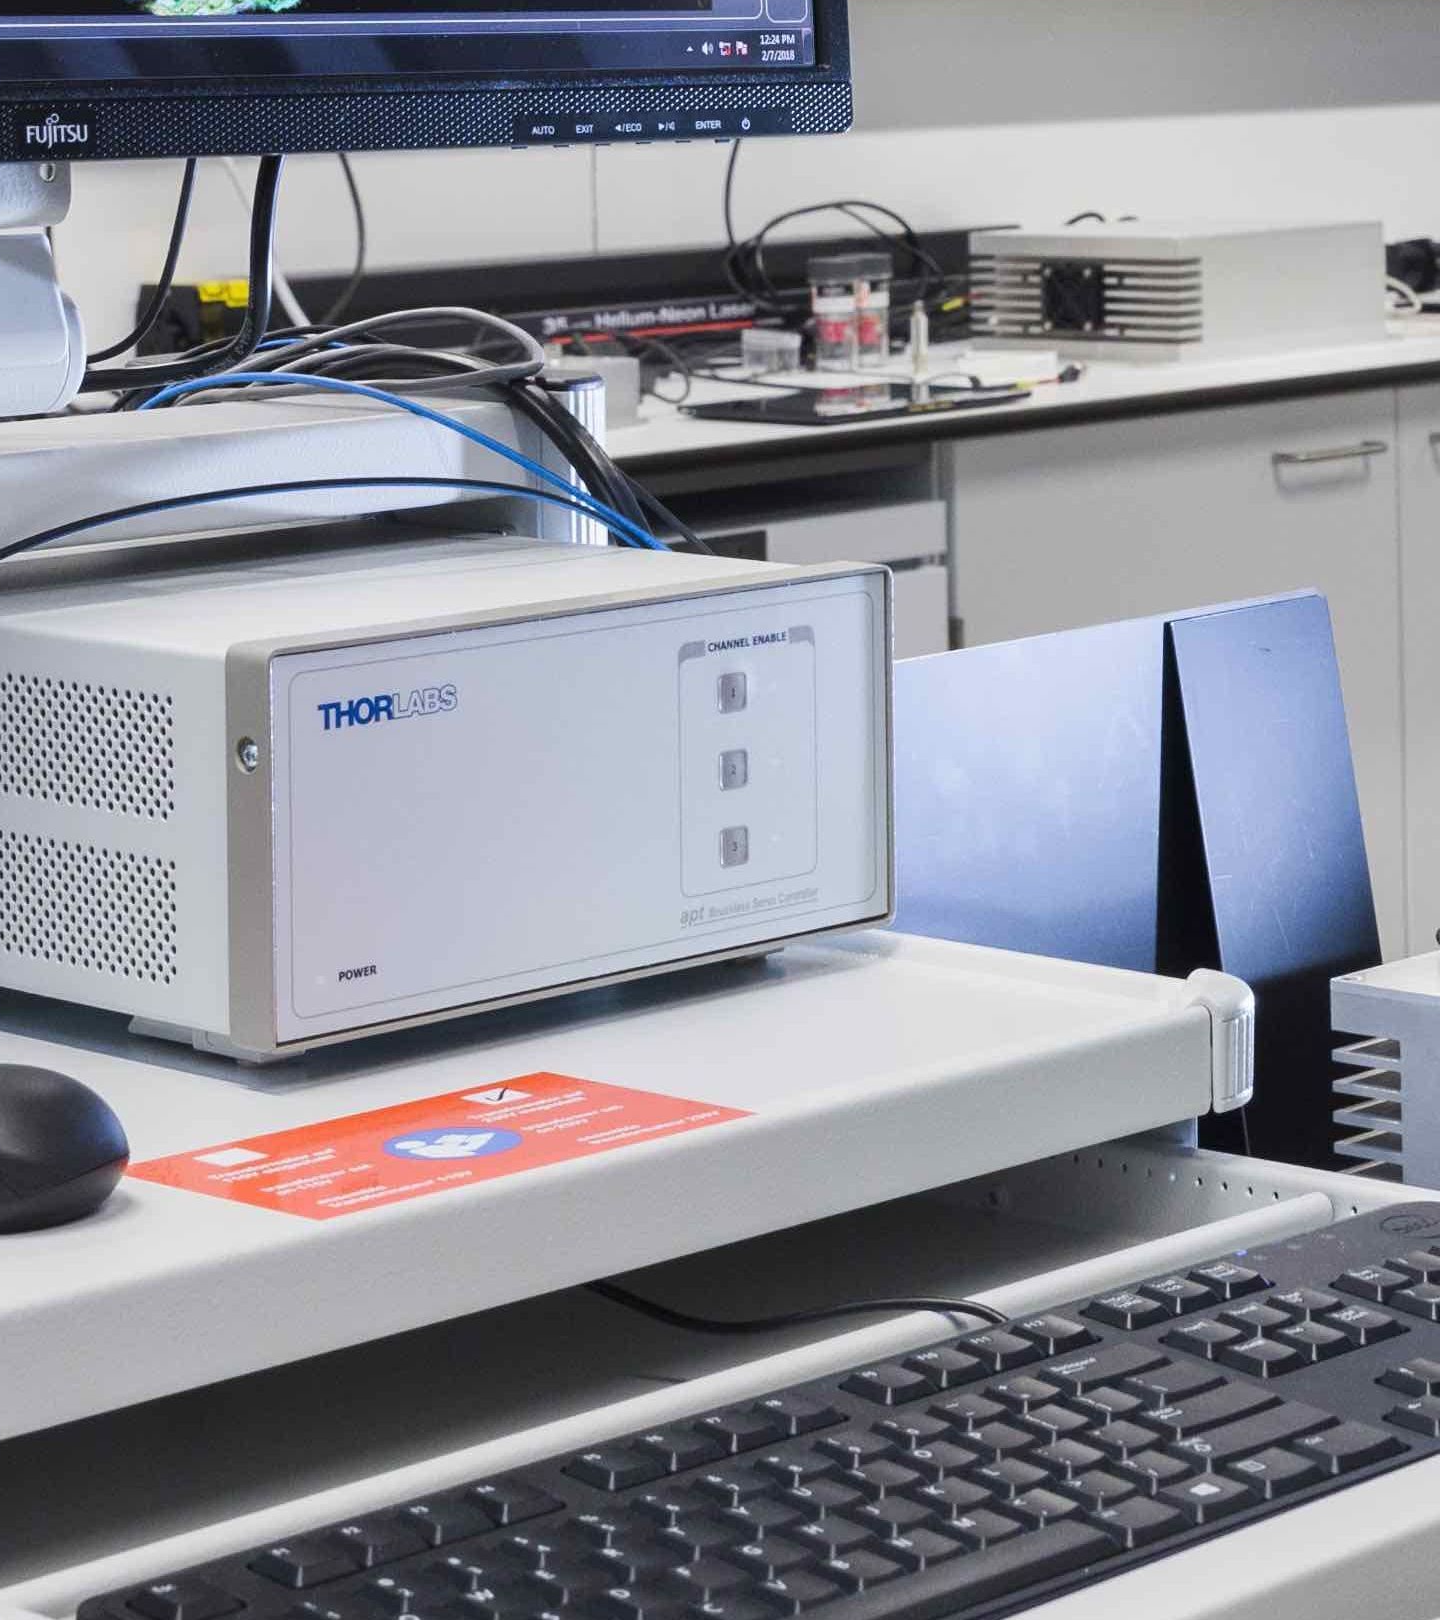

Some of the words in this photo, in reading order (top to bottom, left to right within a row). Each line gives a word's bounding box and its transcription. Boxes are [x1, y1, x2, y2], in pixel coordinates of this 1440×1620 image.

[760, 34, 780, 45] 12:24
[782, 34, 795, 45] PM
[762, 50, 795, 61] 2/7/2018
[26, 114, 89, 149] FUJITSU
[531, 126, 555, 135] AUTO
[576, 124, 594, 134] EXIT
[695, 120, 722, 130] ENTER
[594, 303, 706, 329] Helium-Neon
[707, 636, 750, 653] CHANNEL
[752, 631, 787, 648] ENABLE
[318, 684, 458, 729] THORLABS
[338, 964, 377, 982] POWER
